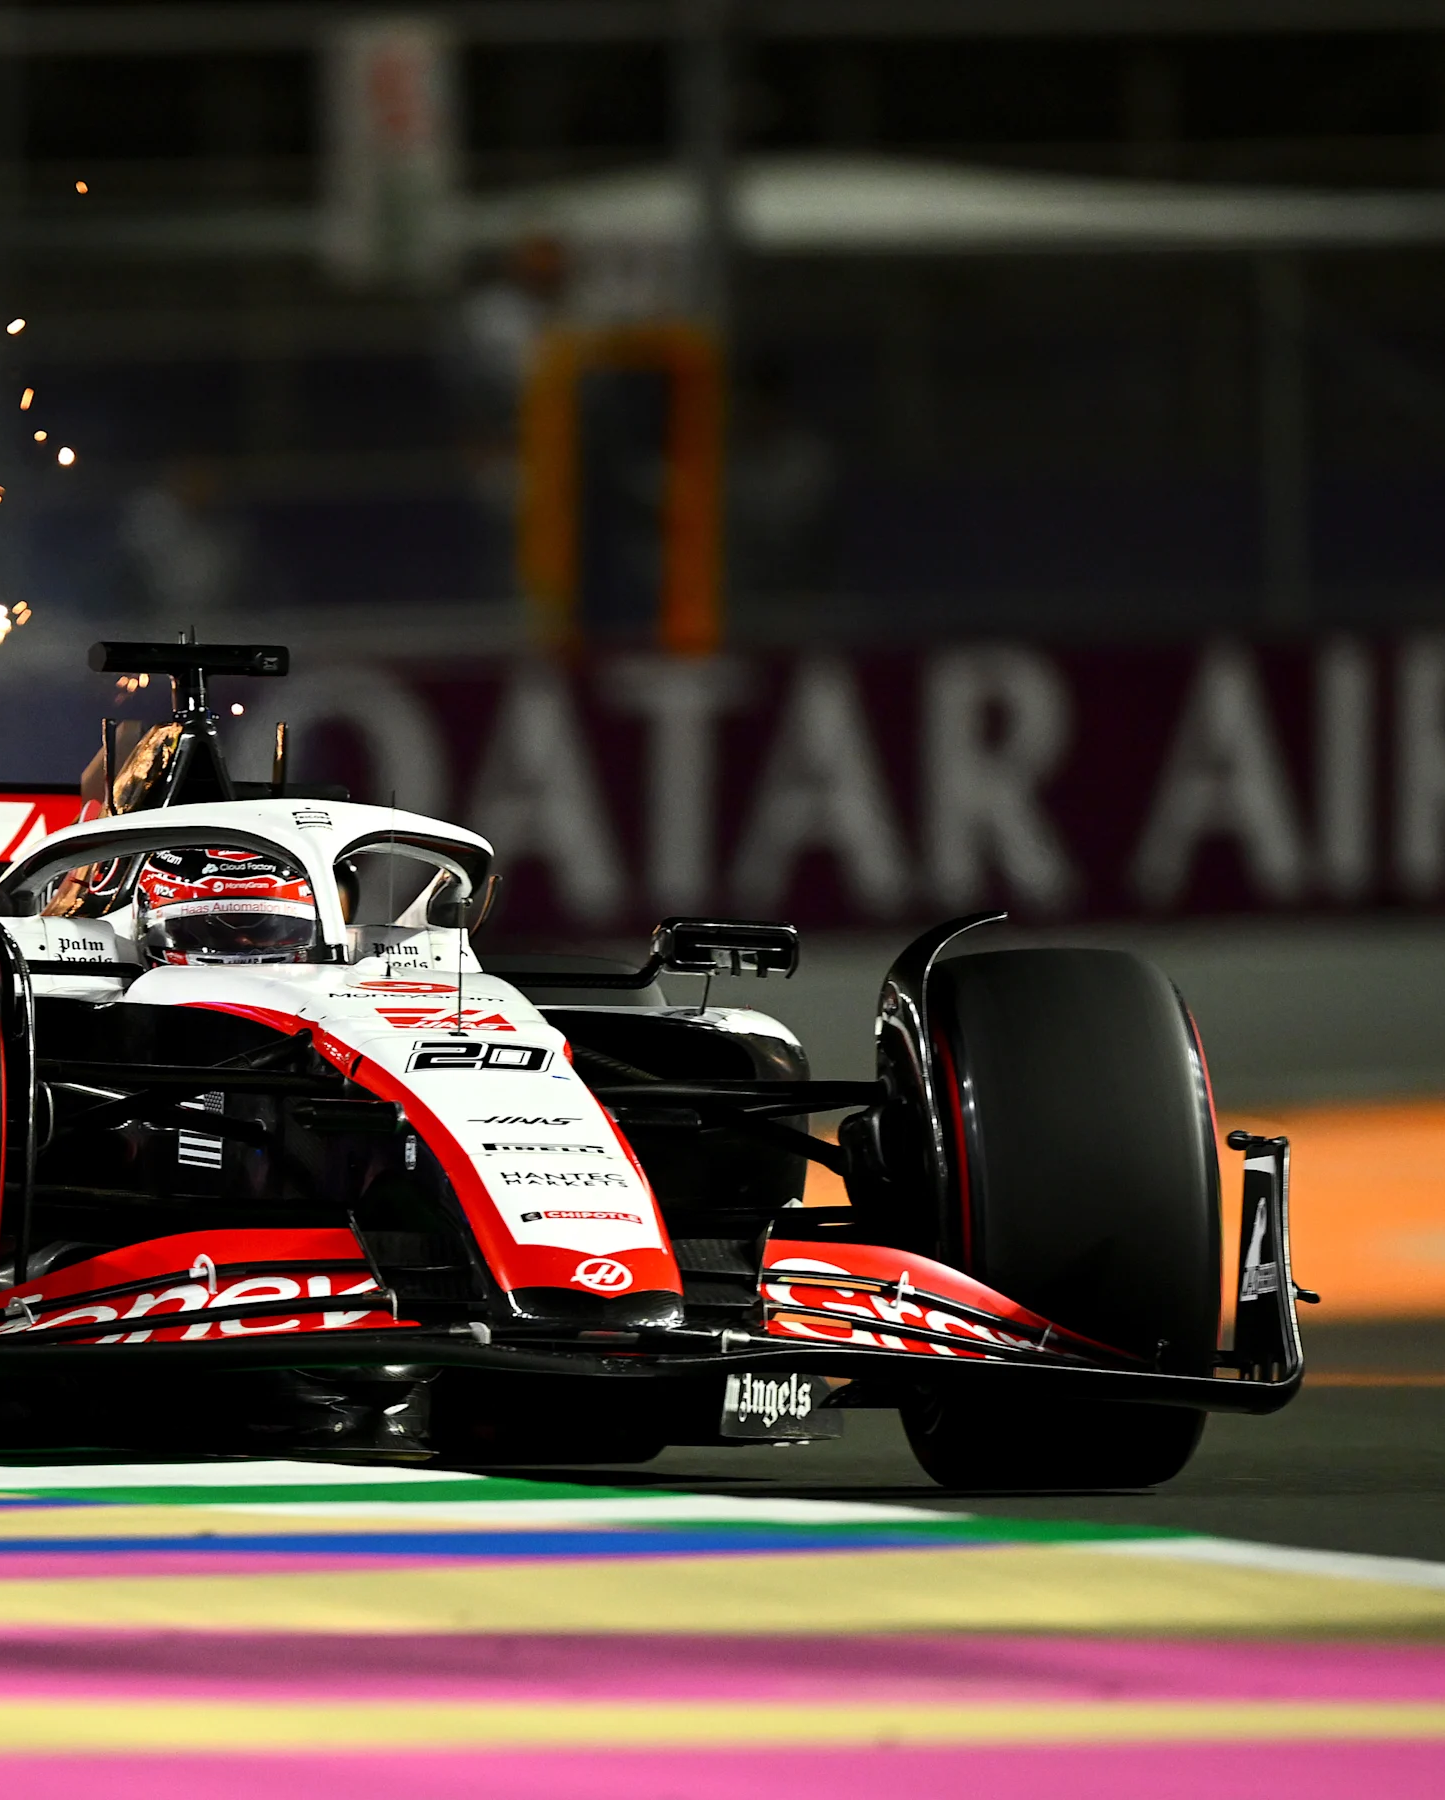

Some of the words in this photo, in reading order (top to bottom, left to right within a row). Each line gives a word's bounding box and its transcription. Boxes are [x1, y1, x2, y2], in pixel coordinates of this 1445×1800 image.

[247, 862, 277, 873] Factory
[225, 881, 269, 889] MoneyGram
[180, 903, 209, 916] Haas
[212, 901, 282, 914] Automation
[58, 938, 105, 953] Palm
[372, 943, 419, 957] Palm
[329, 992, 505, 1002] MoneyGram
[405, 1040, 555, 1074] 20
[466, 1115, 584, 1126] HAAS
[500, 1171, 626, 1182] HANTEC
[504, 1179, 629, 1188] MARKETS
[544, 1210, 642, 1224] CHIPOTLE
[738, 1373, 812, 1428] Angels
